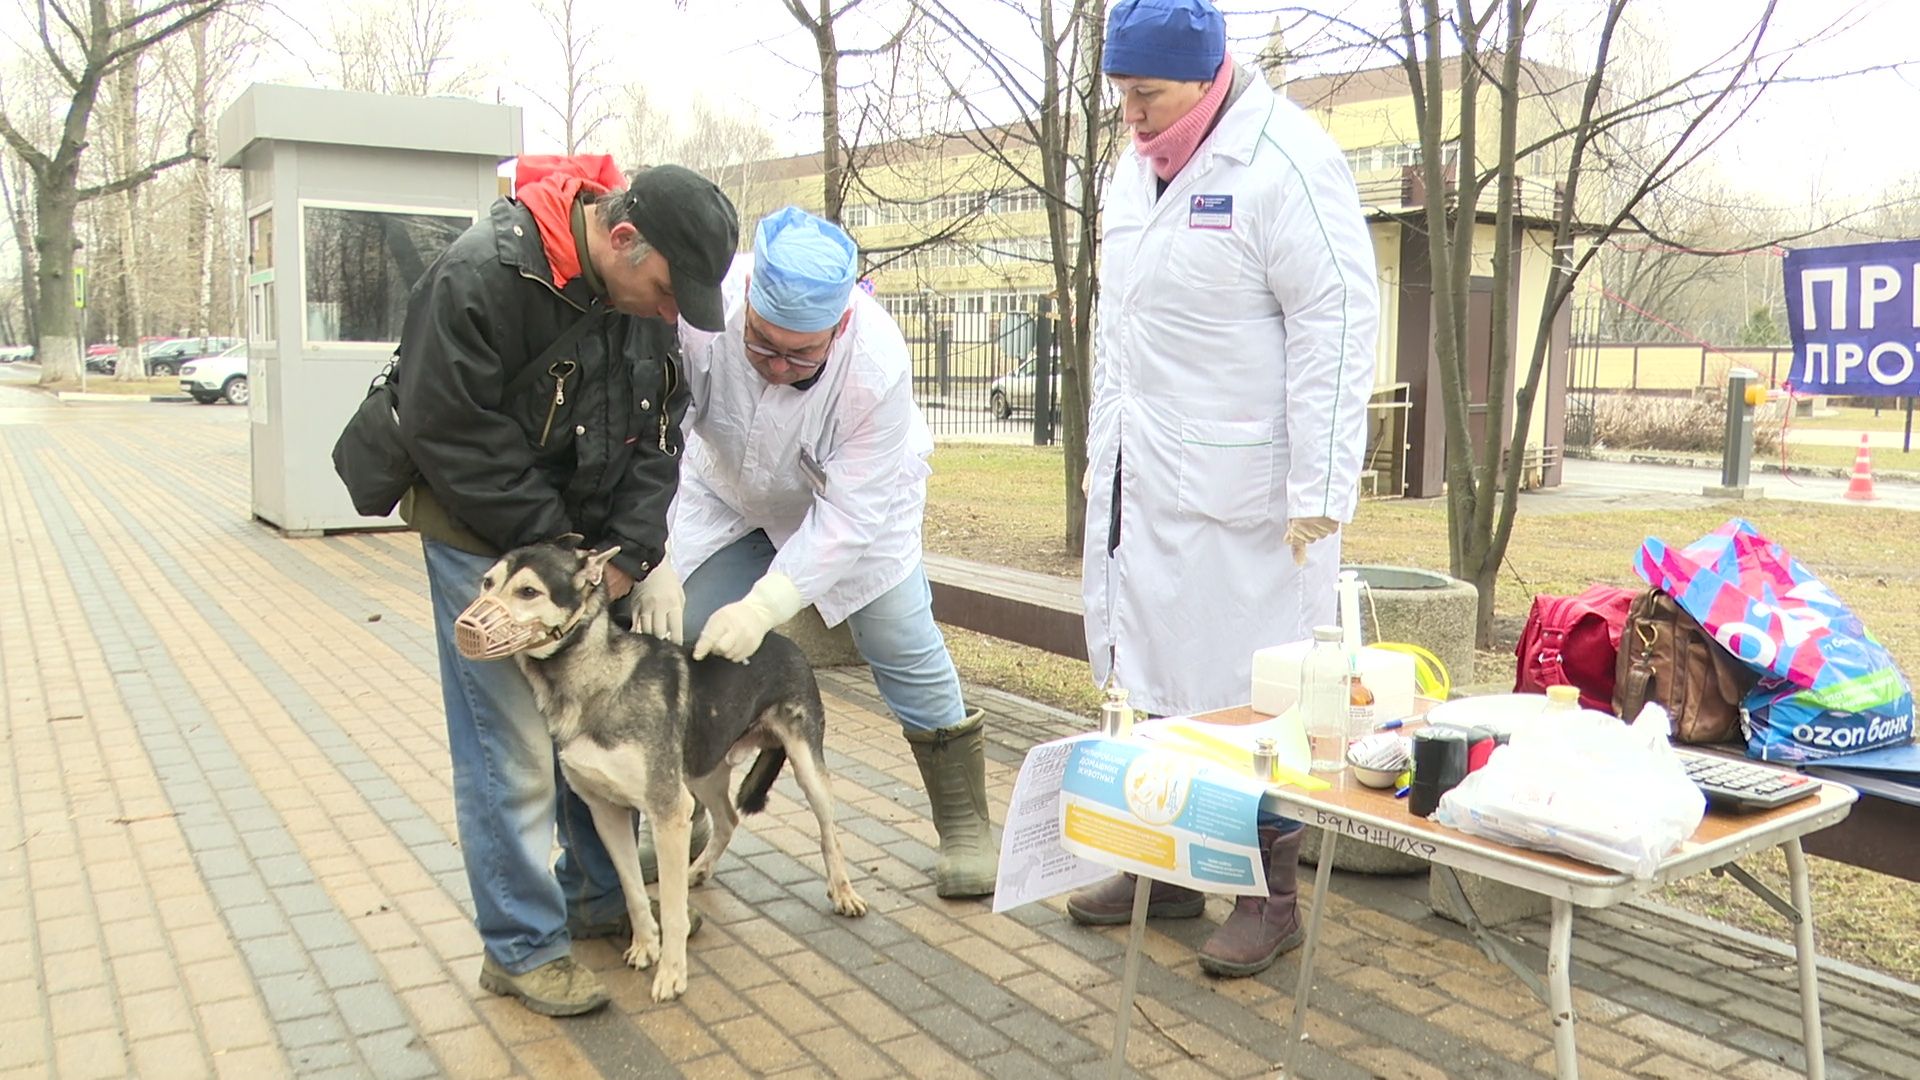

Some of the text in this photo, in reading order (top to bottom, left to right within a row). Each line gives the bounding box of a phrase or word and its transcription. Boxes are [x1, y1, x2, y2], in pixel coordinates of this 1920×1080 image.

[1801, 262, 1920, 331] ПР
[1803, 341, 1920, 386] ПРО
[1867, 714, 1908, 743] банк
